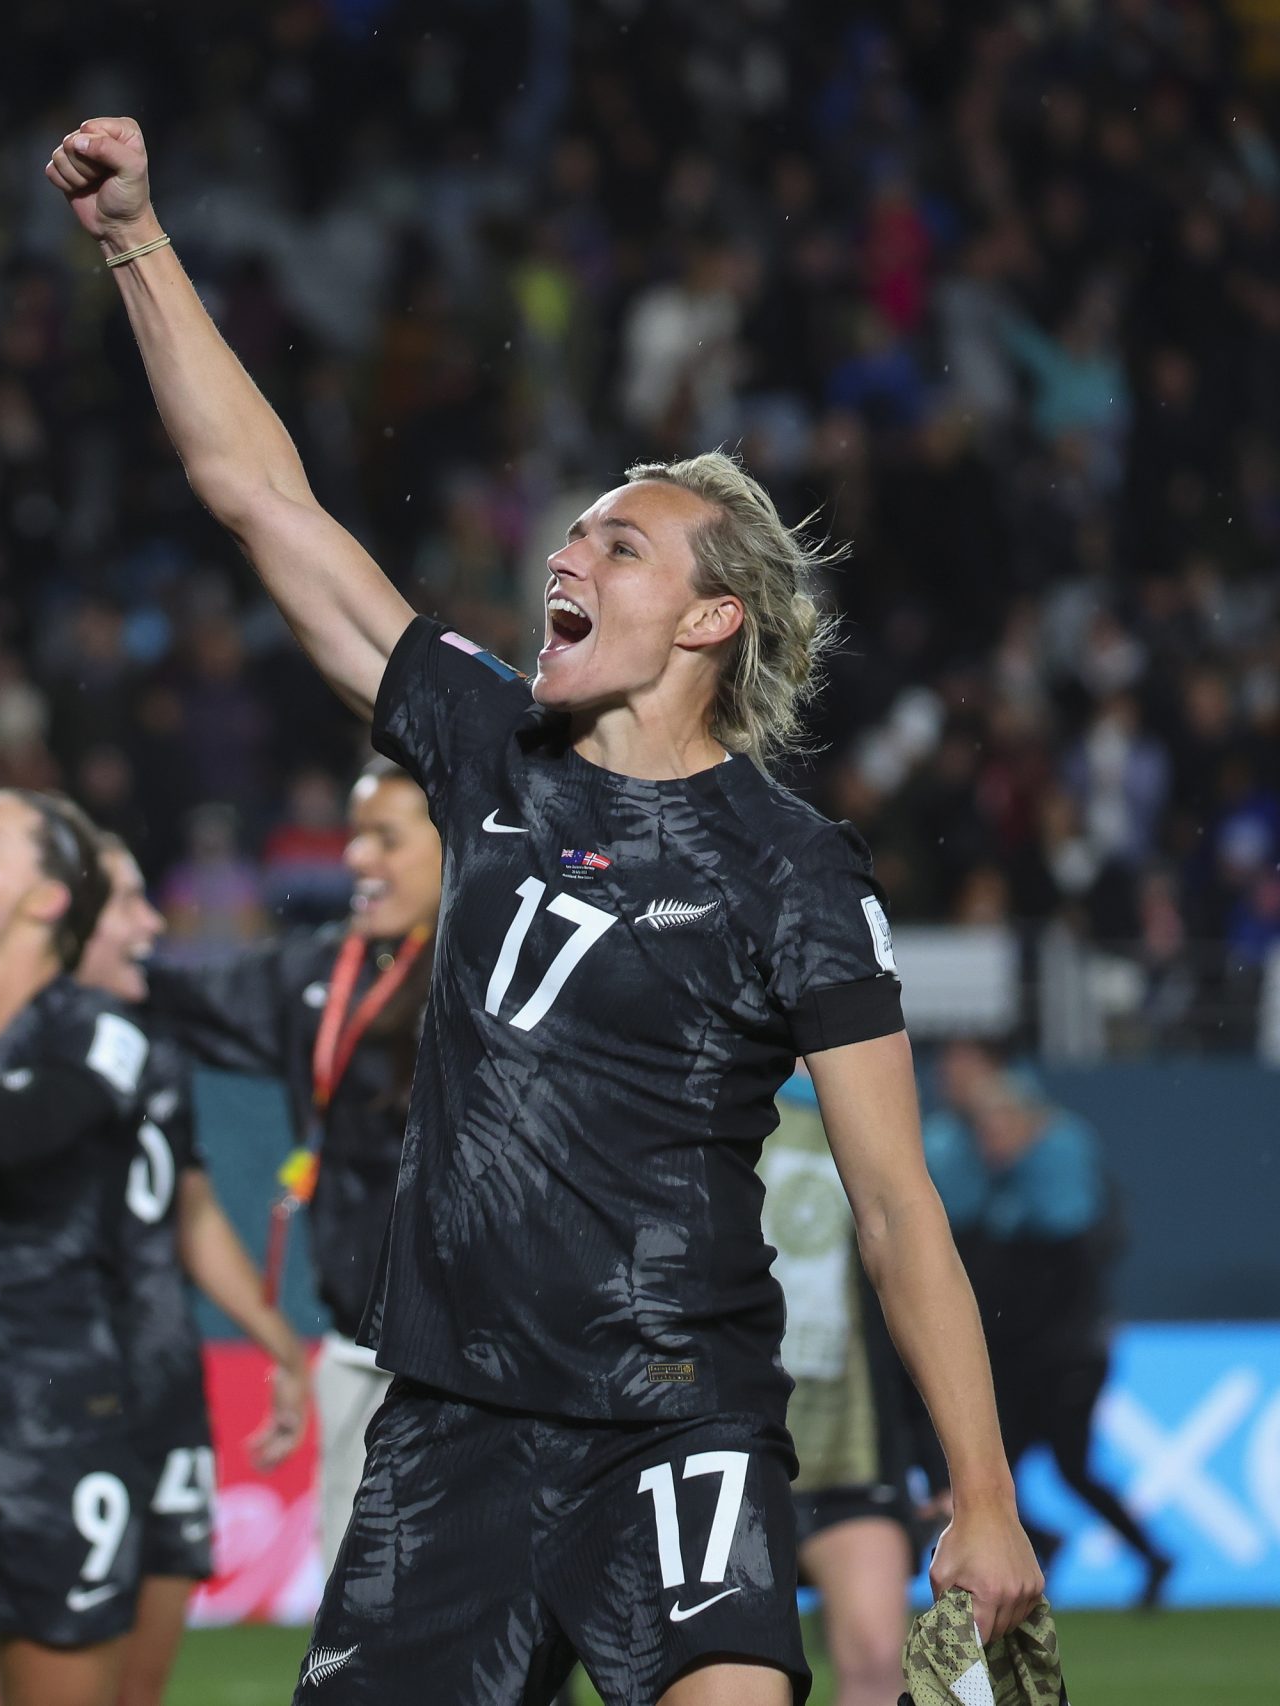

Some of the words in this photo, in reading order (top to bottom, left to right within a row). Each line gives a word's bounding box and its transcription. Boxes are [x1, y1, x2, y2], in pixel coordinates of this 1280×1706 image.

[485, 875, 619, 1032] 17
[72, 1471, 129, 1582] 9
[636, 1450, 750, 1589] 17
